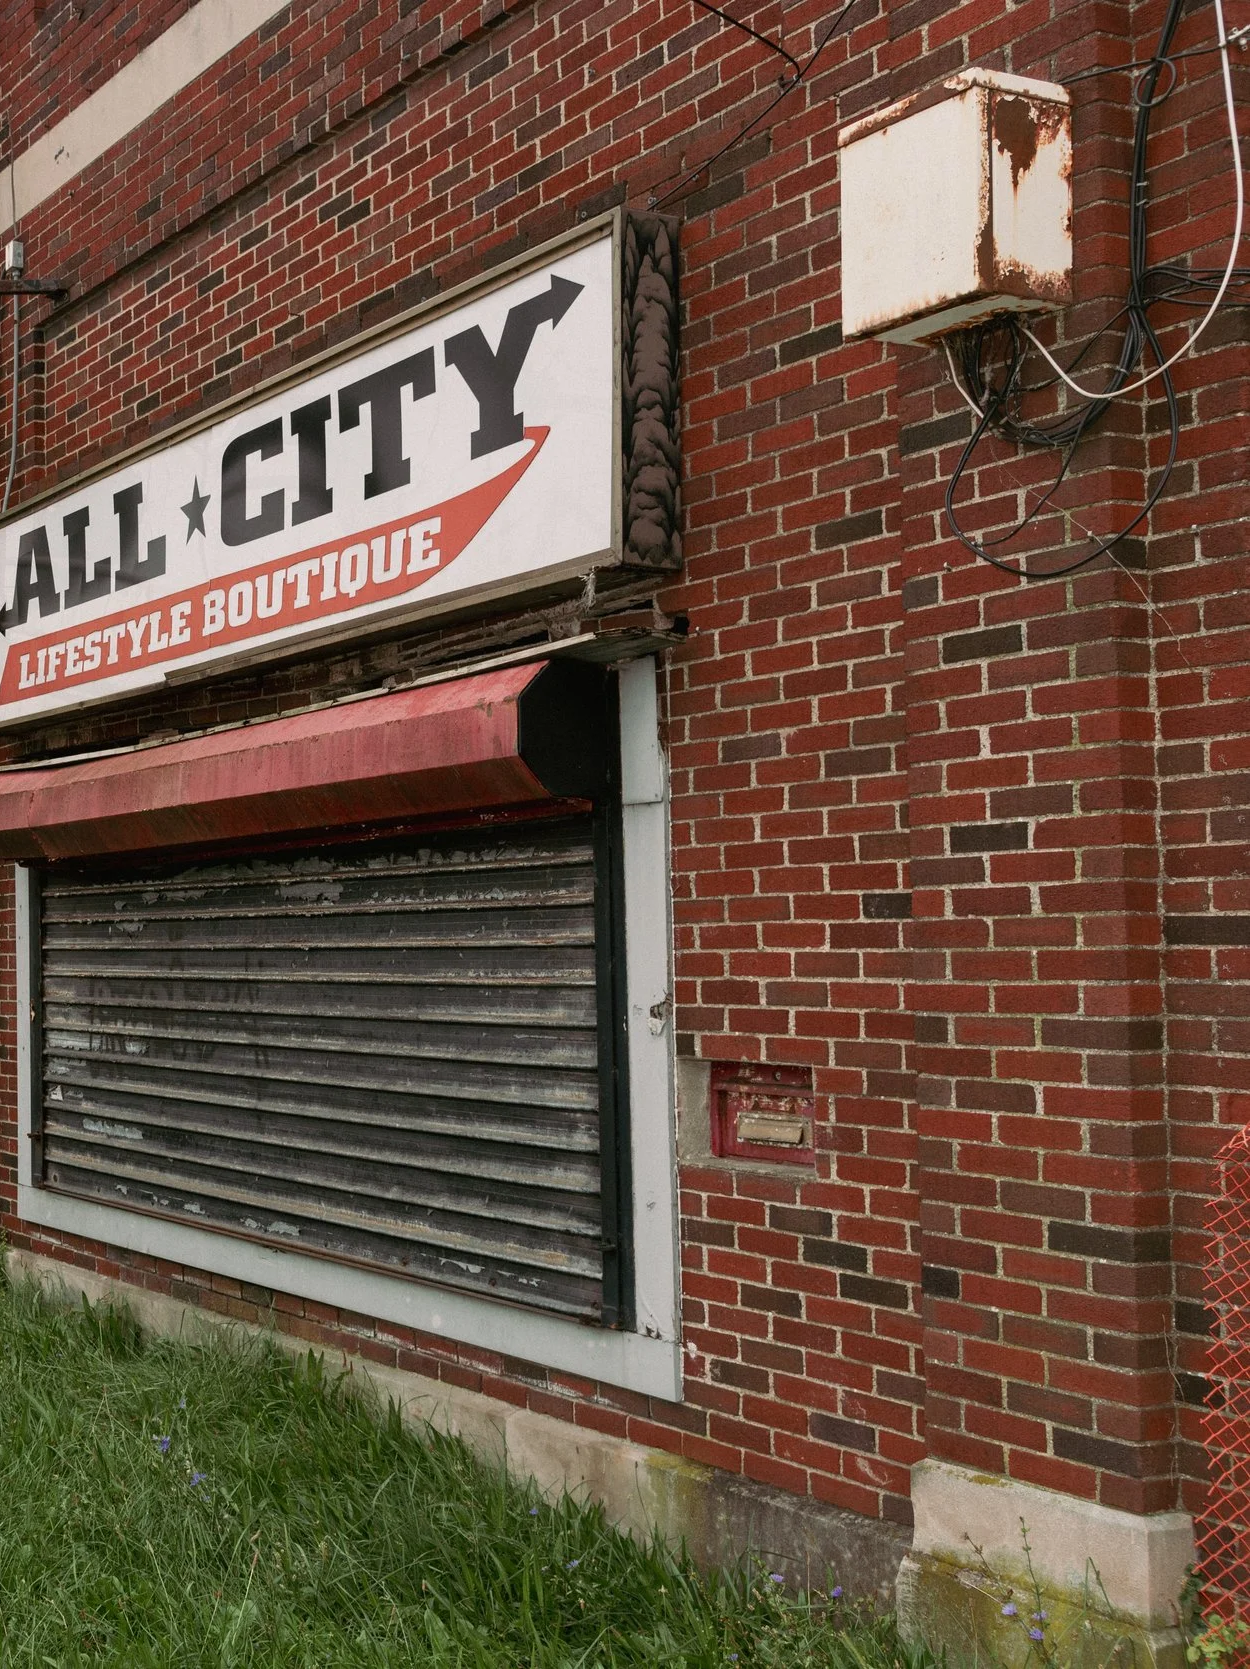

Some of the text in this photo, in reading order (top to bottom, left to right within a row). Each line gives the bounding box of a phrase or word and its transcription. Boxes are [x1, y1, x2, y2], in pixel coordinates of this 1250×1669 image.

[2, 284, 558, 630] ALL CITY
[18, 516, 442, 690] LIFESTYLE BOUTIQUE
